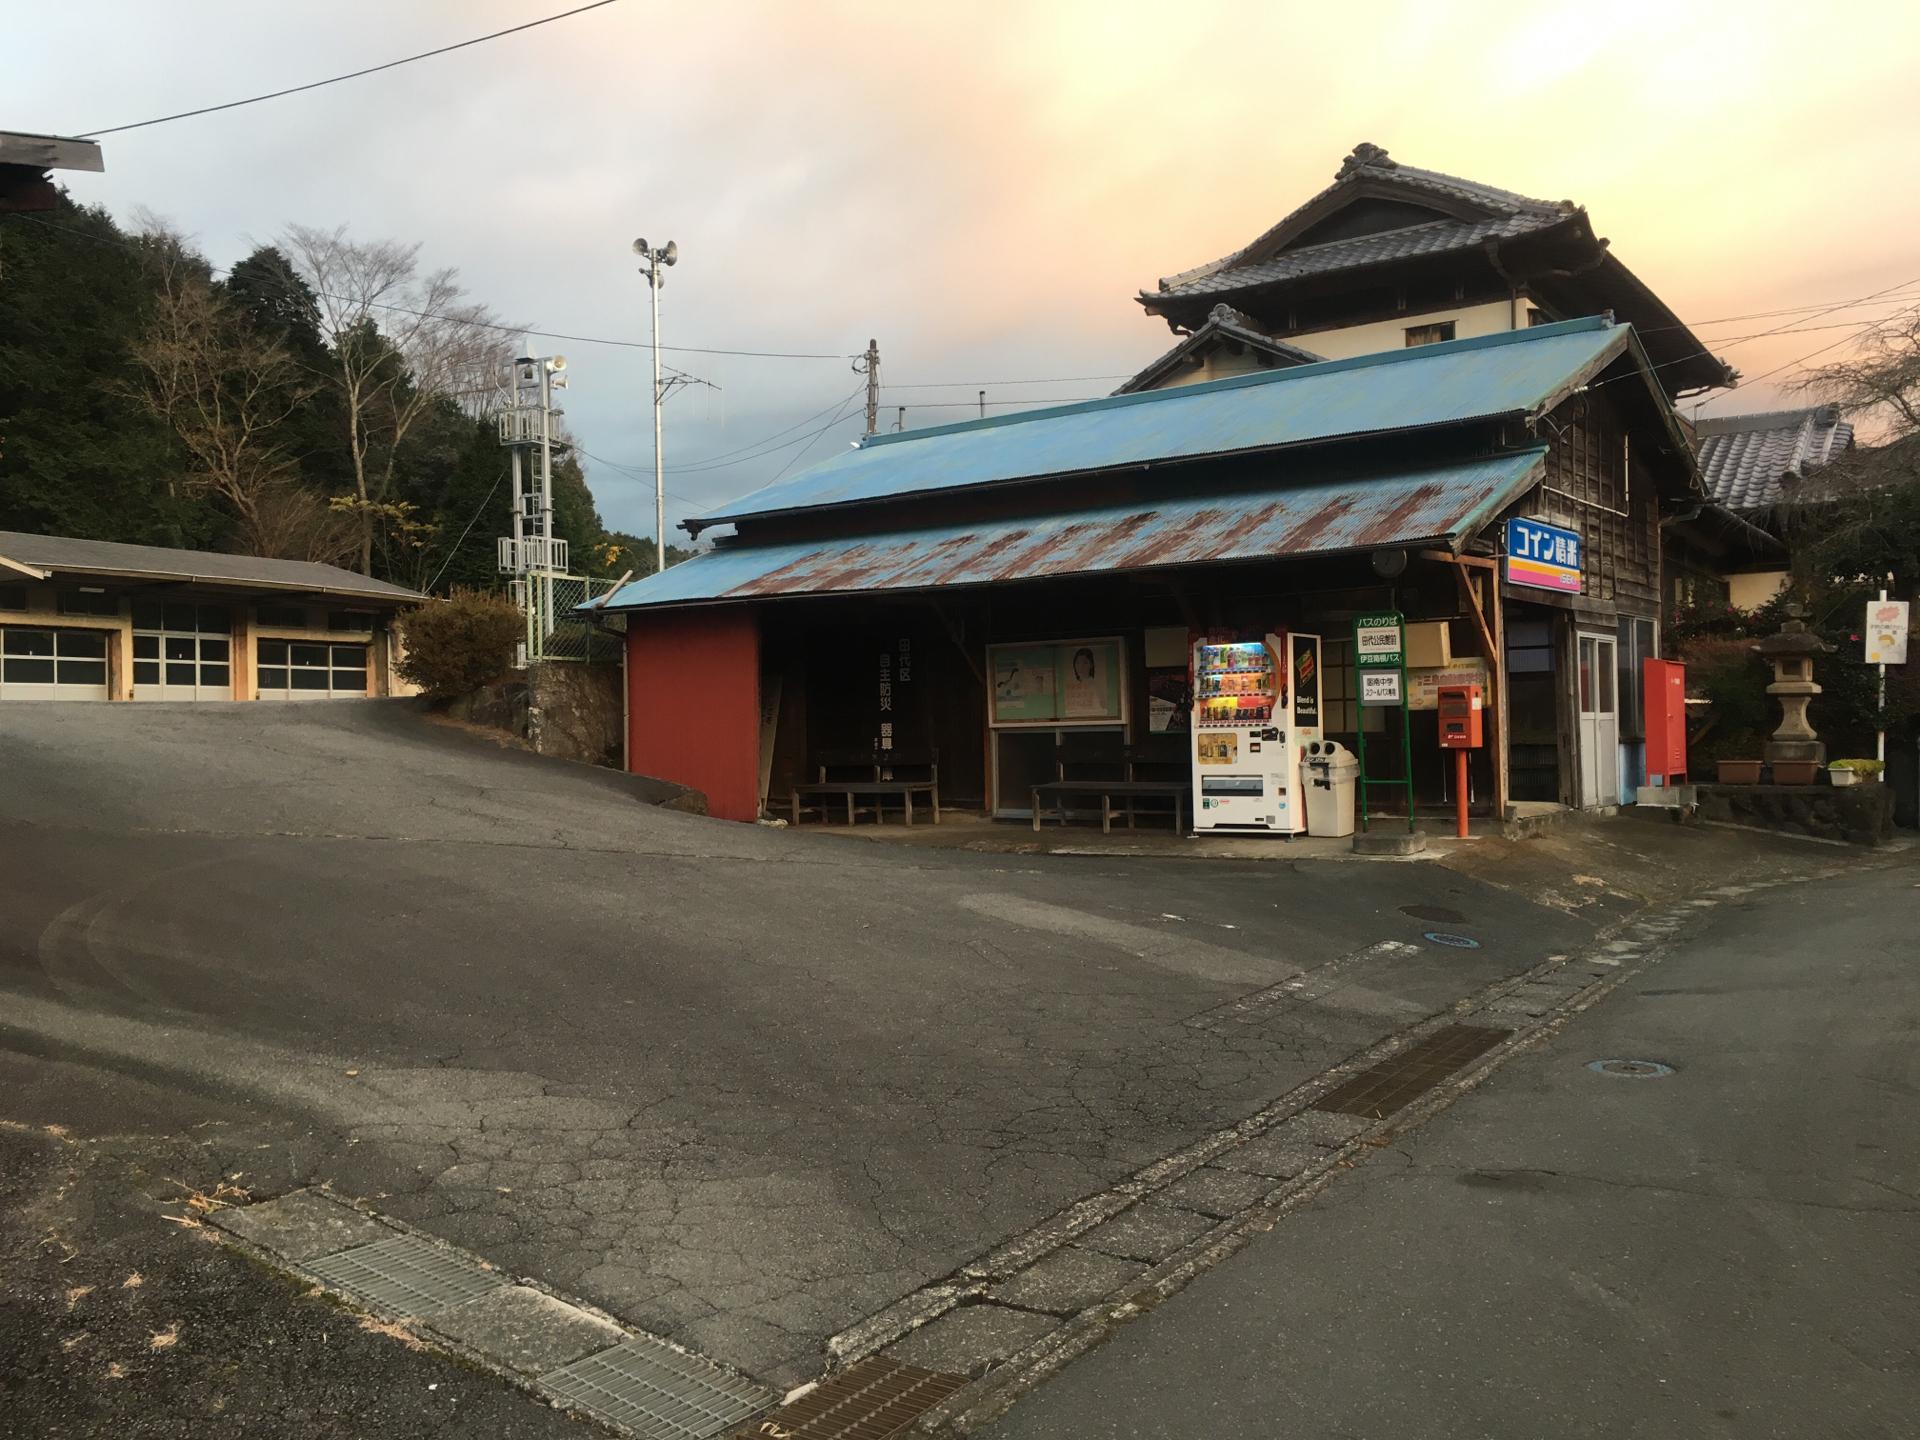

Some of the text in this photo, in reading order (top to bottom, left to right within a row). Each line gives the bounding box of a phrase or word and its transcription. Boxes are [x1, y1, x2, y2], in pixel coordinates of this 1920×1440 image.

[1516, 526, 1577, 567] コイン精米
[1358, 615, 1398, 628] バスのりば
[898, 638, 912, 682] 田代区
